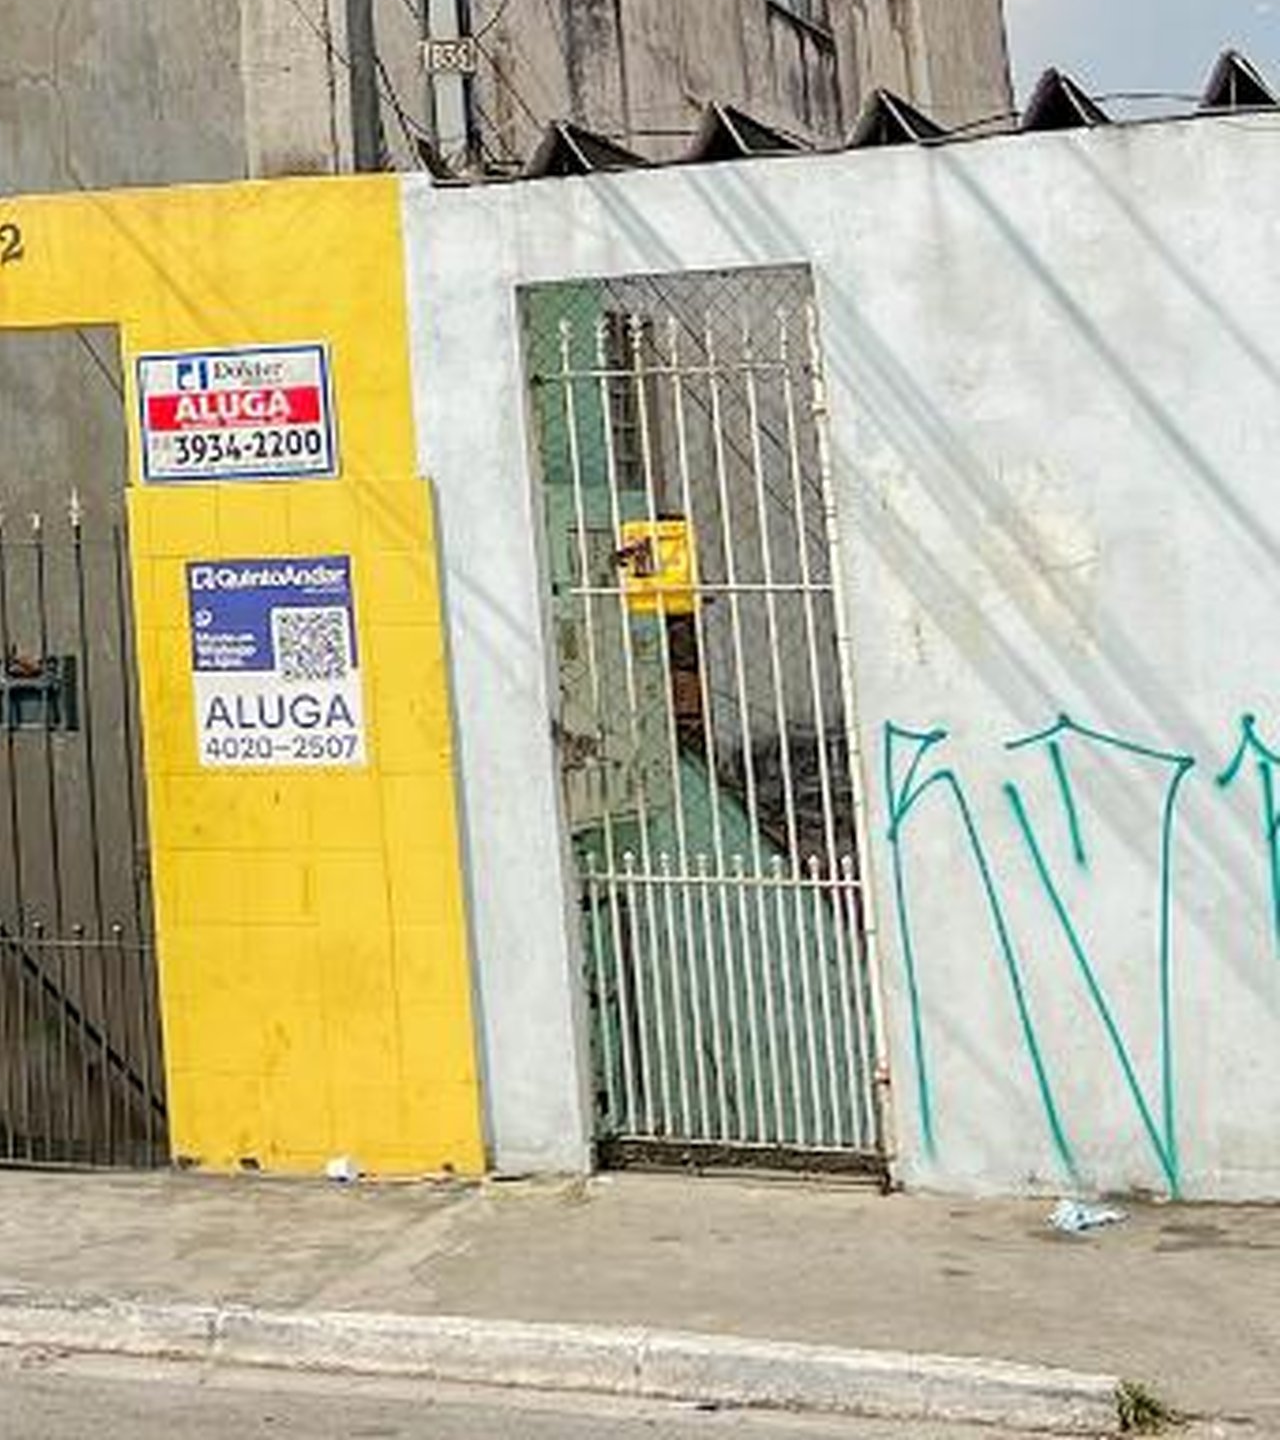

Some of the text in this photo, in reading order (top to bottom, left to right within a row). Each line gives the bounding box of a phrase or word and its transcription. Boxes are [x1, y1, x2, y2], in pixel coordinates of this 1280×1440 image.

[175, 391, 292, 422] ALUGA
[174, 429, 322, 464] 3934-2200
[205, 693, 356, 730] ALUGA
[206, 734, 359, 760] 4020-2507
